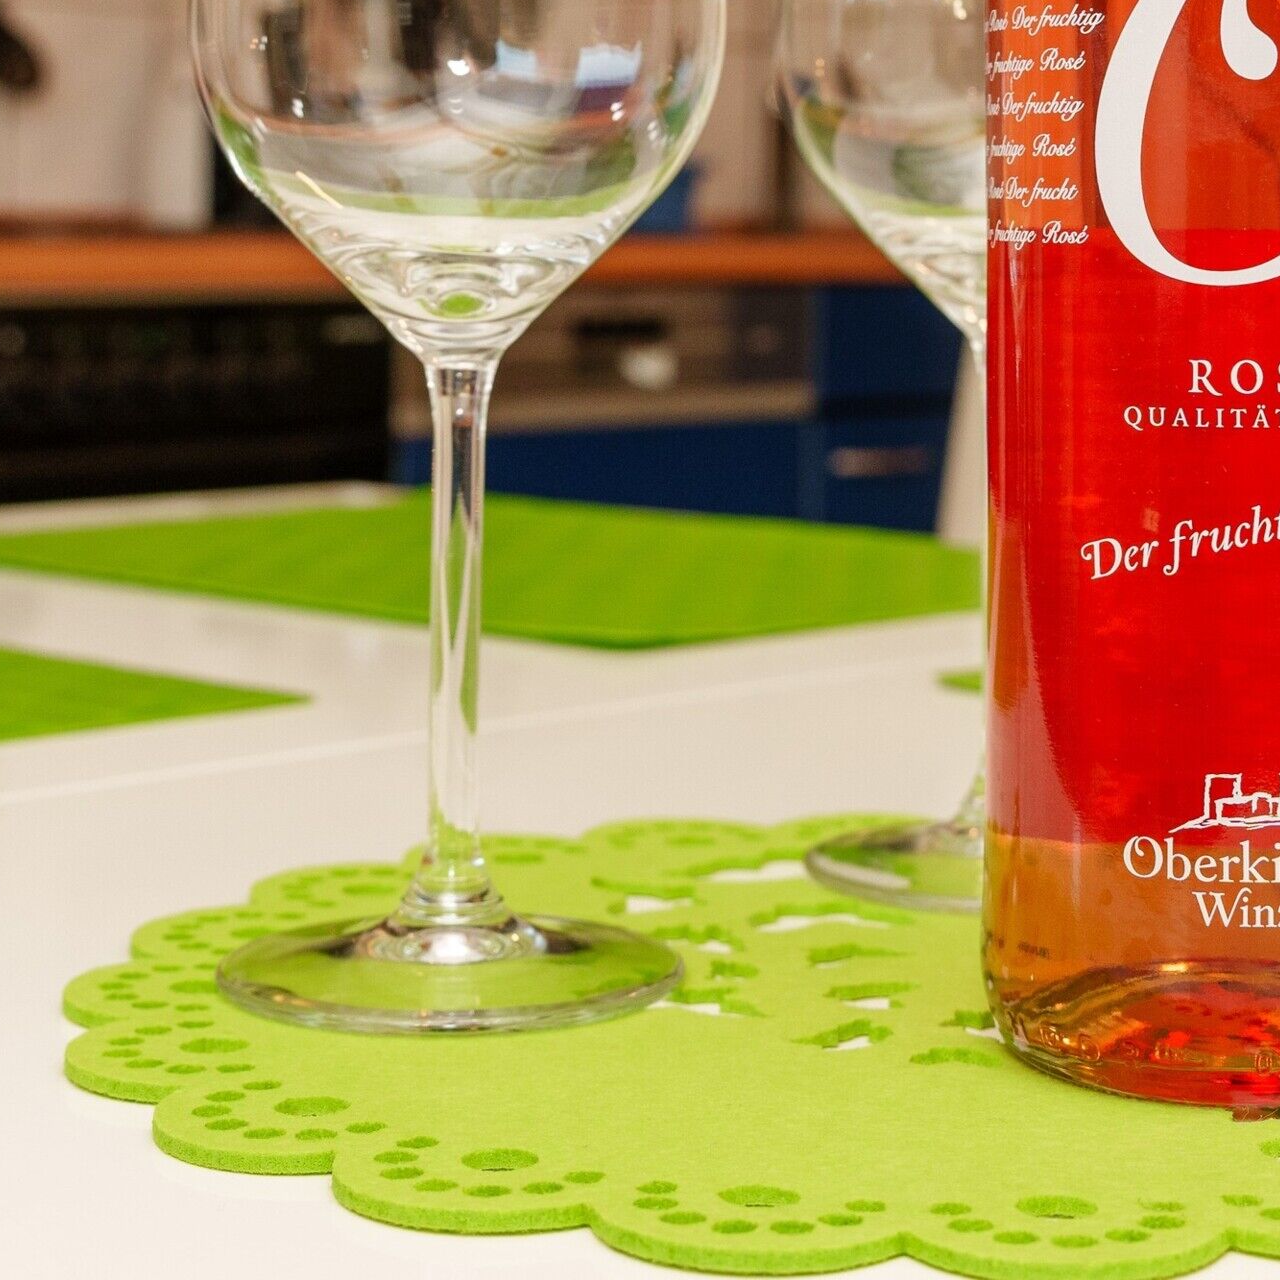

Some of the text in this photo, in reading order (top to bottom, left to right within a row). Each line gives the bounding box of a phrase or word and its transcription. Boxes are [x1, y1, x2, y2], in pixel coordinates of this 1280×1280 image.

[1012, 6, 1037, 30] Der
[1029, 4, 1105, 36] fruchtig
[990, 51, 1034, 81] fruchtige
[1040, 48, 1085, 70] Rosé
[1002, 92, 1022, 115] Der
[1016, 91, 1084, 121] fruchtig
[1032, 134, 1076, 157] Rosé
[1005, 176, 1029, 200] Der
[1022, 177, 1078, 207] frucht
[991, 220, 1036, 250] fruchtige
[1042, 220, 1089, 244] Rosé
[1080, 536, 1159, 580] Der
